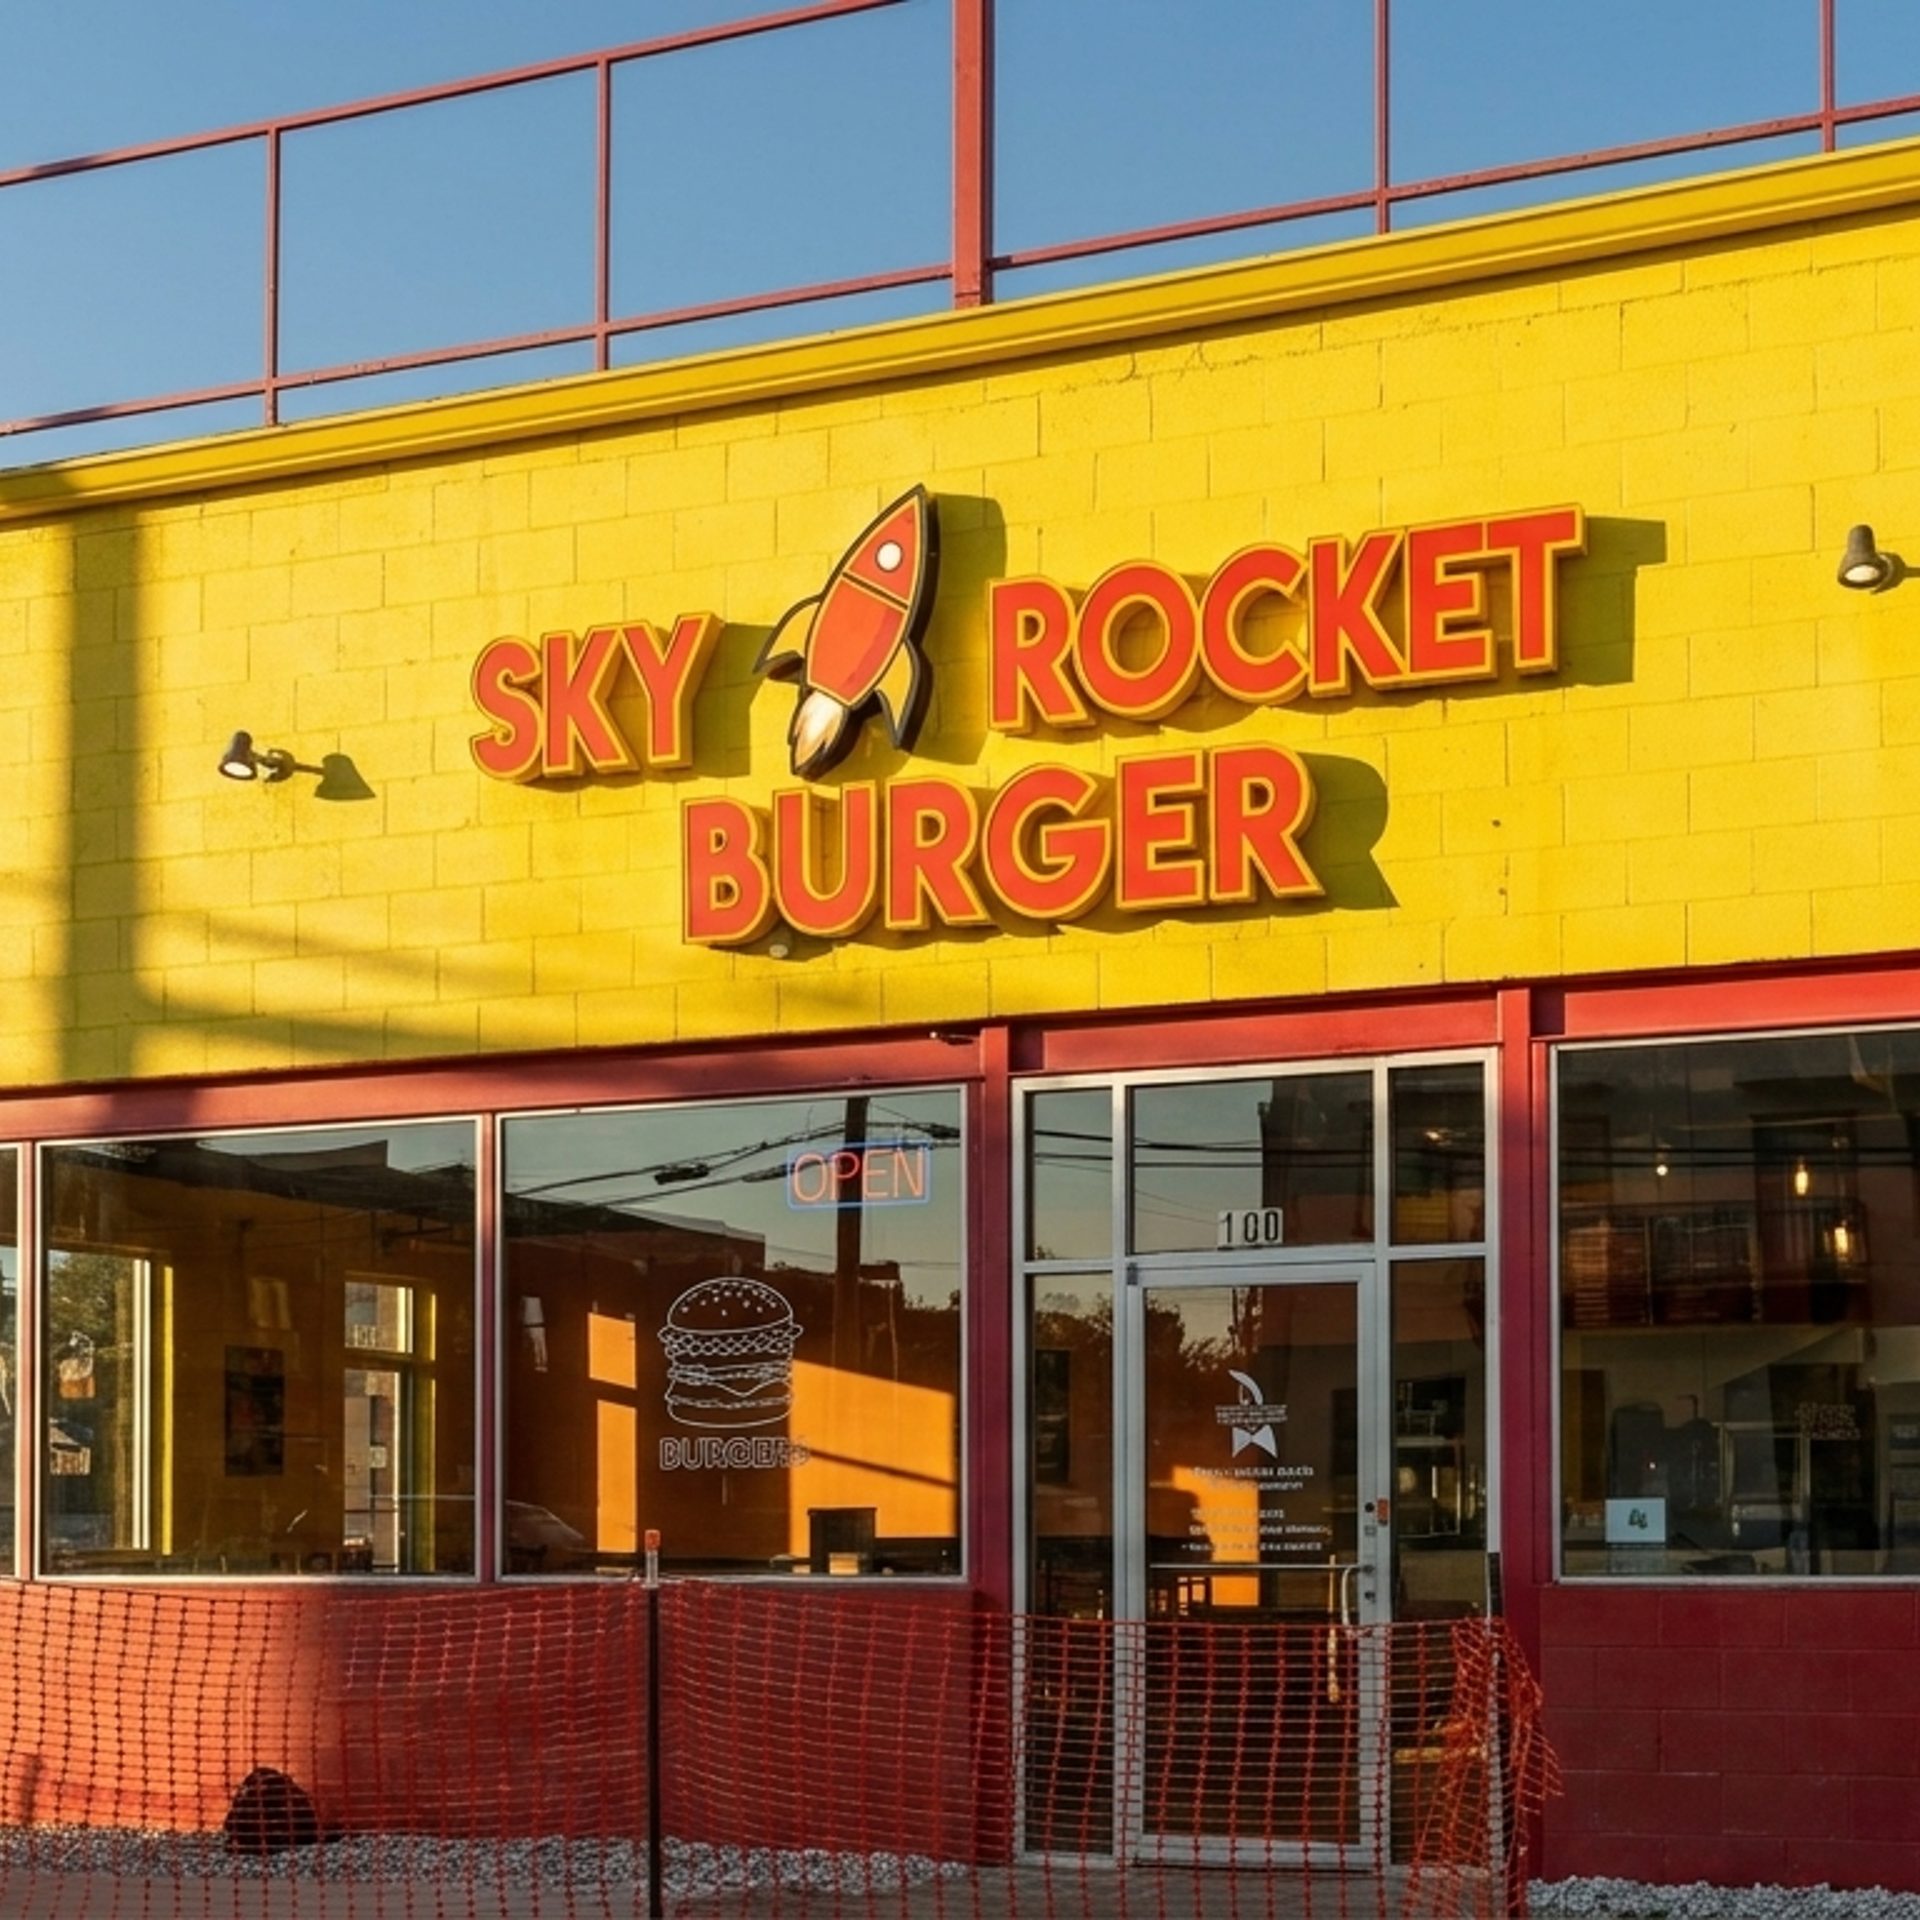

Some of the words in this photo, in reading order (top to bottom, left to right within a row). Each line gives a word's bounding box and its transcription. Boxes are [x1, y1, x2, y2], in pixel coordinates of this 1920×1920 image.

[469, 611, 722, 784] SKY
[985, 504, 1586, 734] ROCKET
[682, 741, 1326, 946] BURGER
[793, 1146, 924, 1203] OPEN
[1219, 1210, 1279, 1244] 100
